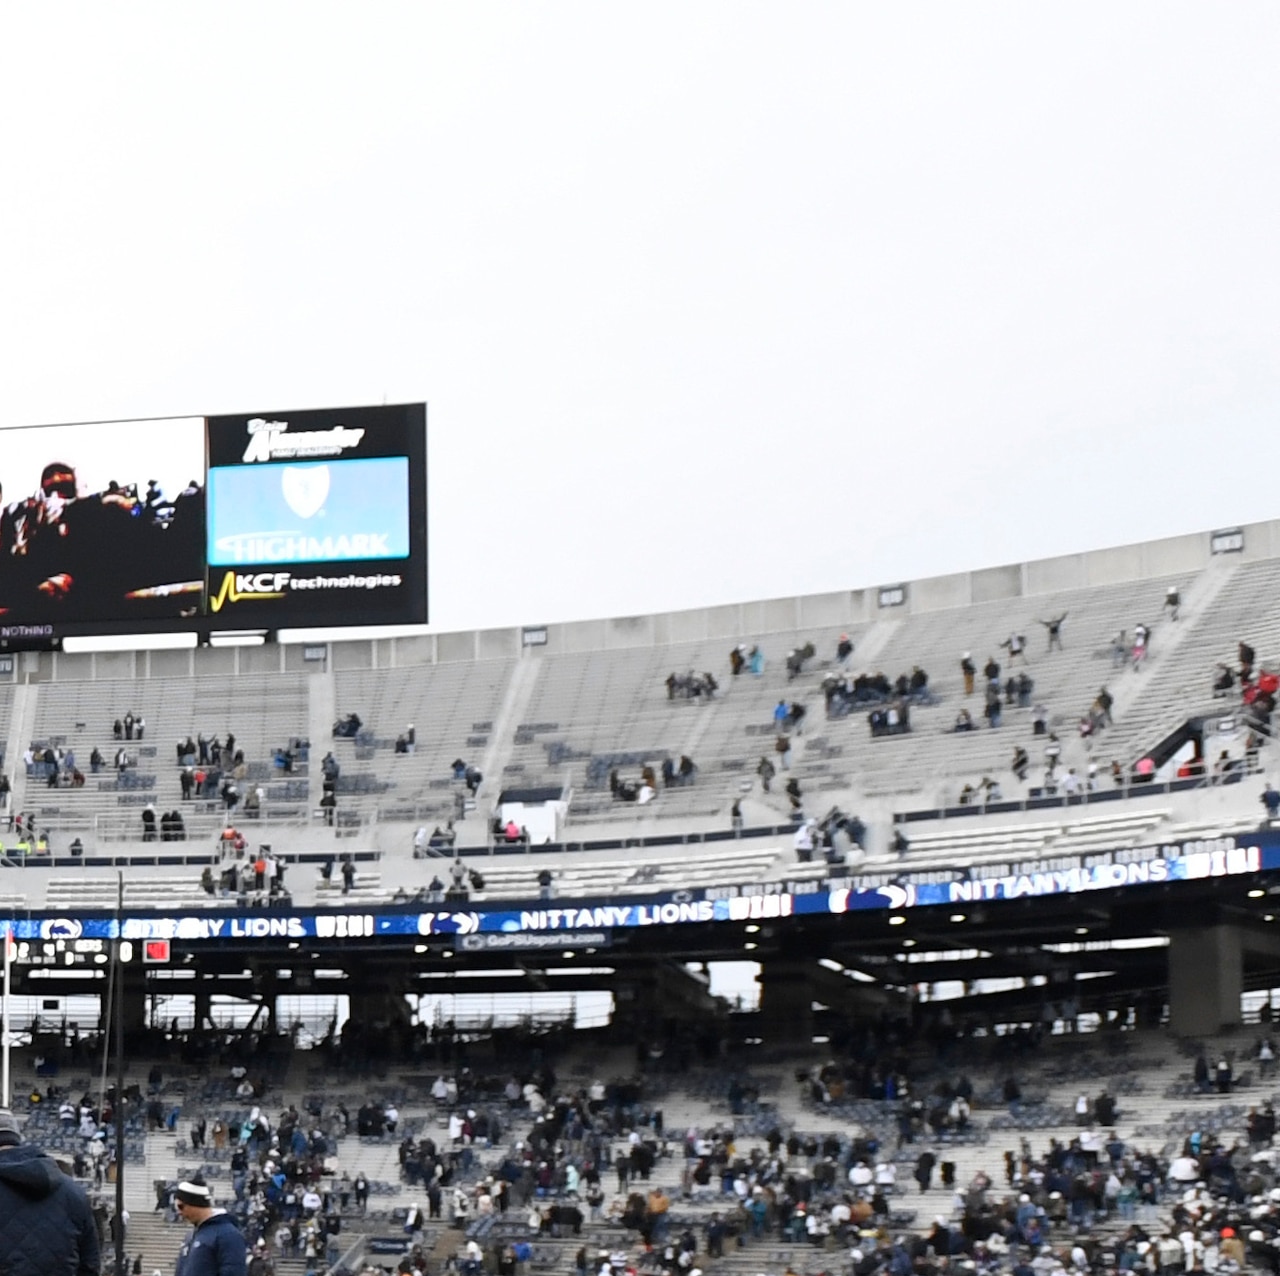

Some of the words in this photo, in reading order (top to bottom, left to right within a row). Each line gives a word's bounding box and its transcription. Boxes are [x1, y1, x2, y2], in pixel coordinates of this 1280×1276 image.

[232, 532, 391, 562] HIGHMARK
[236, 572, 291, 592] KCF
[290, 574, 402, 590] technologies
[1, 624, 54, 636] NOTHING
[949, 866, 1081, 901] NITTANY
[520, 906, 631, 931] NITTANY
[638, 900, 715, 926] LIONS
[728, 893, 793, 920] WIN!
[230, 917, 303, 937] LIONS
[315, 914, 374, 938] WIN!
[486, 933, 606, 948] GoPSUsports.com
